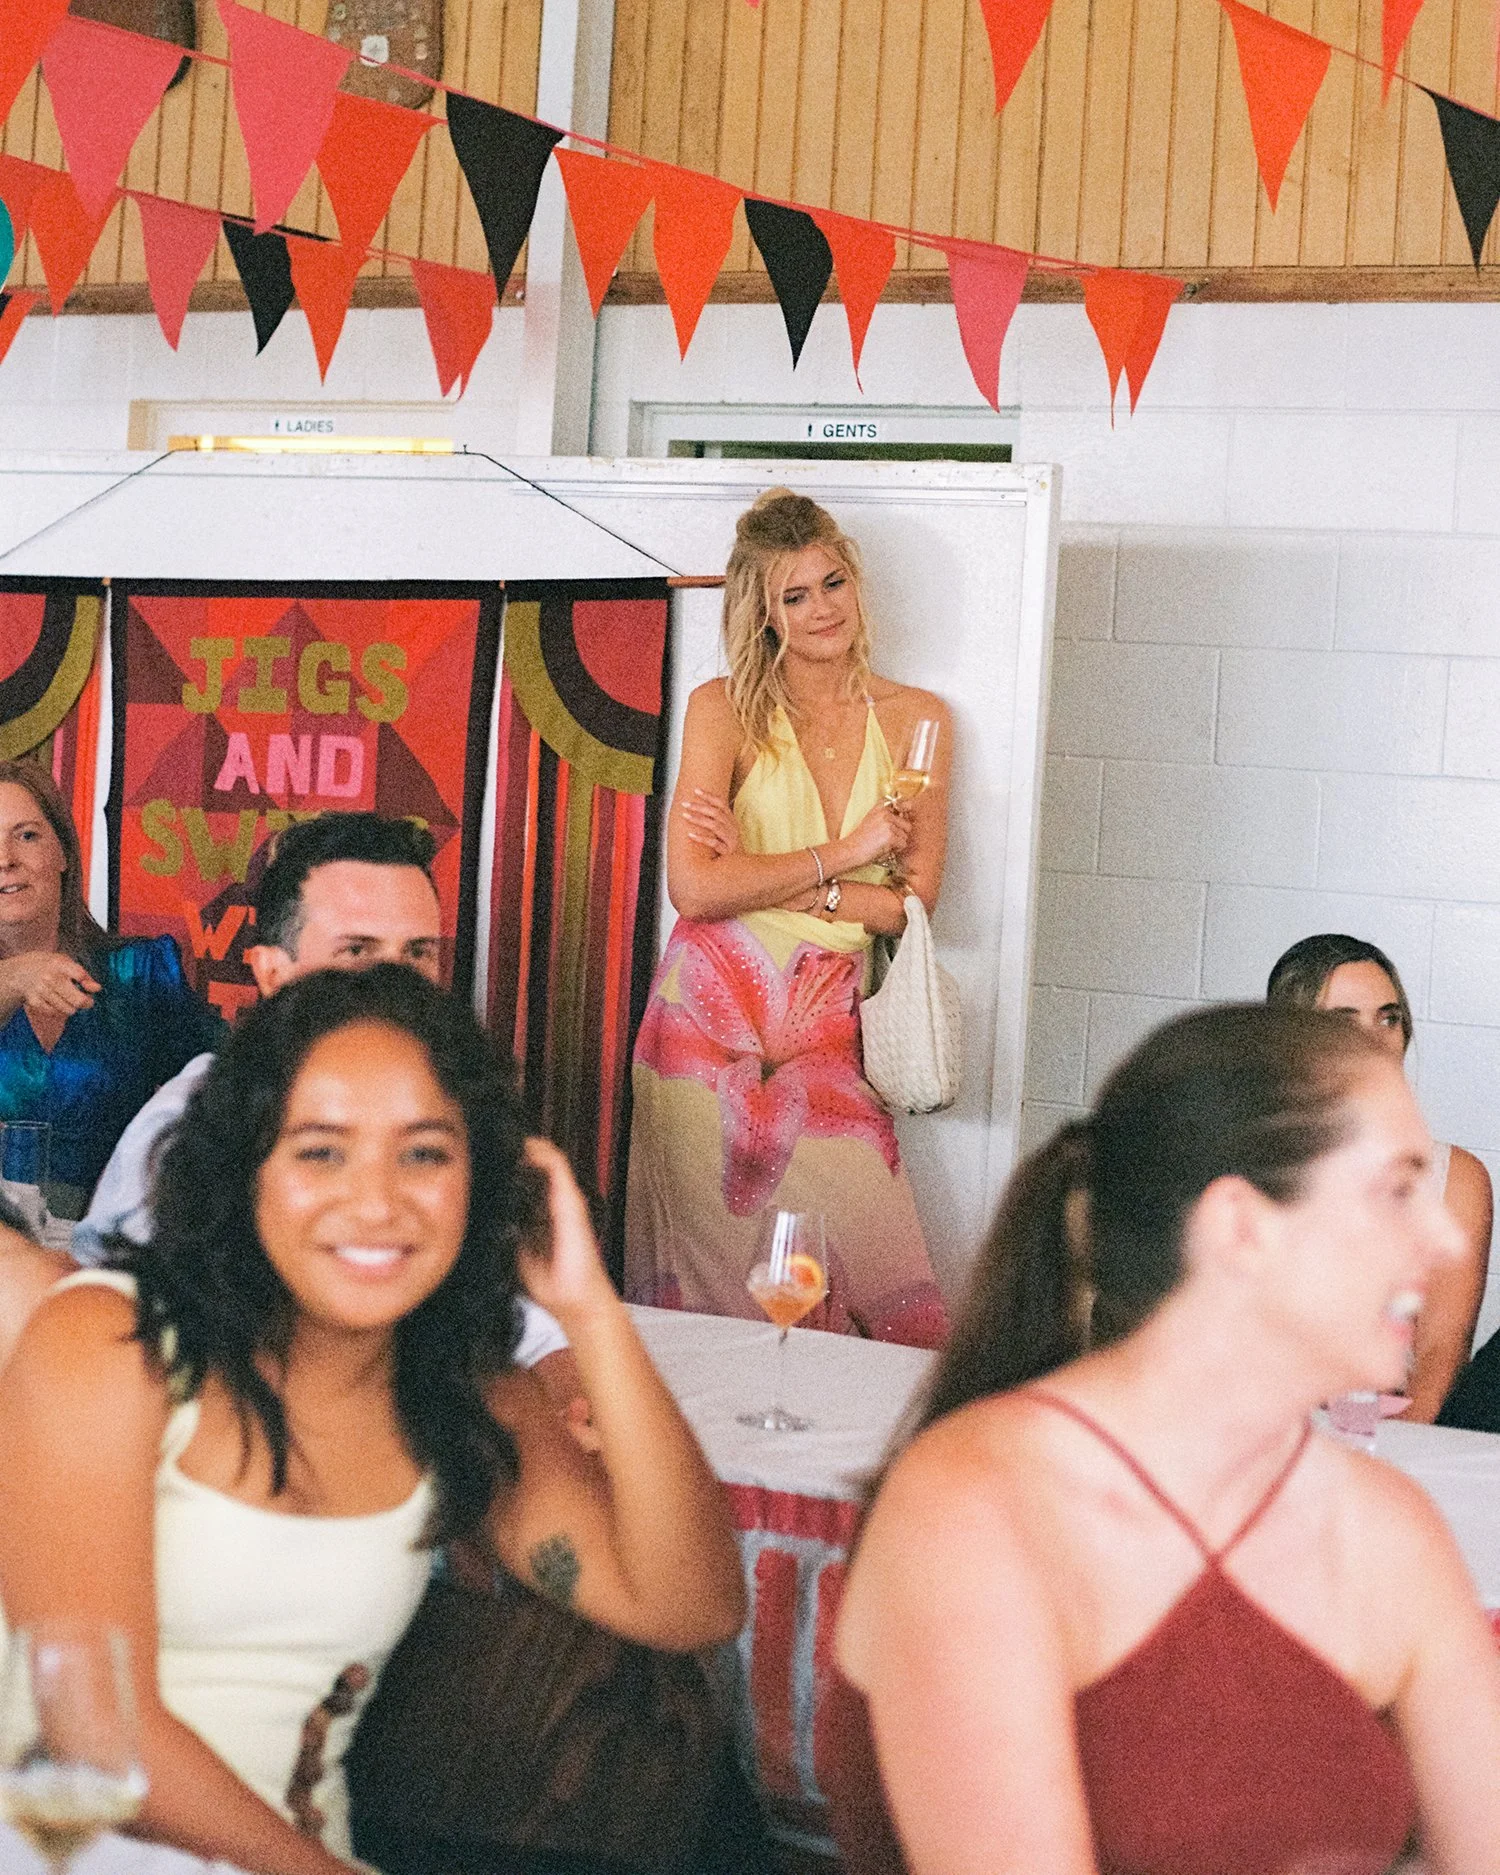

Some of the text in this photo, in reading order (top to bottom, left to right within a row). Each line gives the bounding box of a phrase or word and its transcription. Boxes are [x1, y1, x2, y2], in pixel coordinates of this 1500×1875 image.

[286, 419, 334, 433] LADIES
[823, 424, 877, 438] GENTS
[181, 636, 409, 723] JIGS
[213, 731, 365, 798] AND
